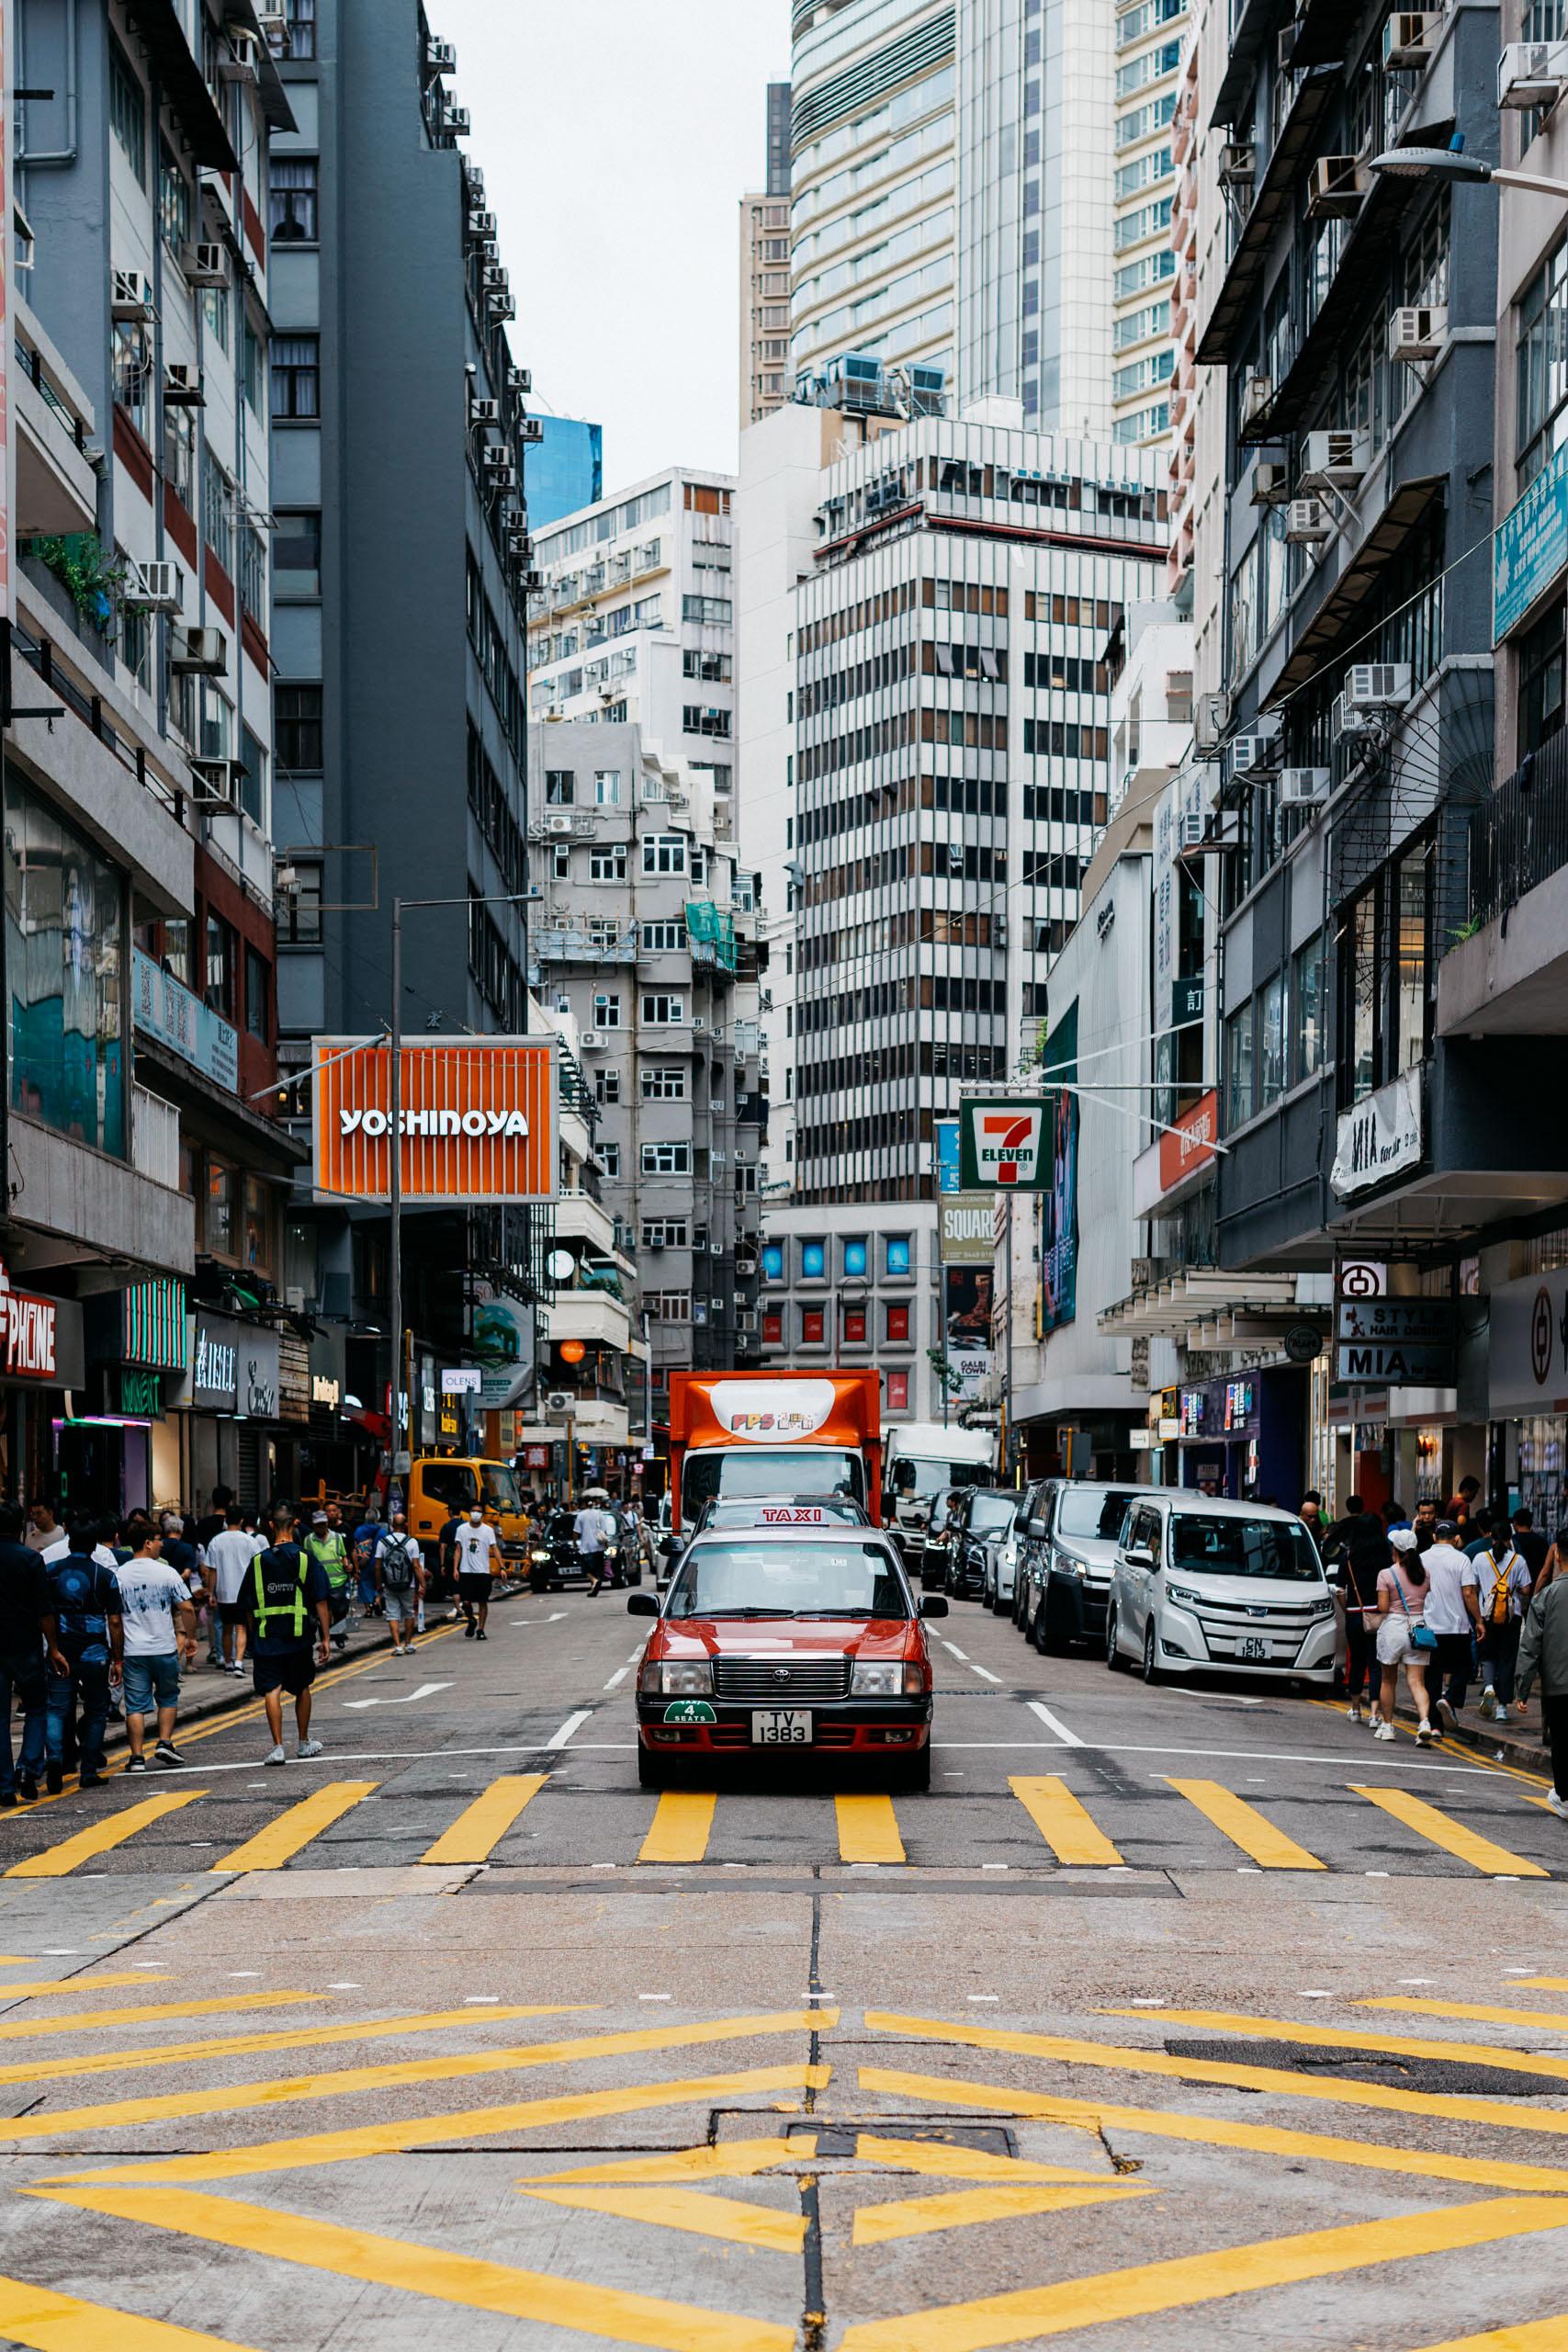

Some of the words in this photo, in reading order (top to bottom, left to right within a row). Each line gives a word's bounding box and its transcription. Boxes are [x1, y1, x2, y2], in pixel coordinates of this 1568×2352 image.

[339, 1109, 529, 1136] YOSHINOYA
[984, 1116, 1032, 1183] 7
[1374, 1308, 1446, 1324] STYLE
[7, 1296, 55, 1372] PHONE
[1371, 1325, 1398, 1336] HAIR
[1348, 1350, 1408, 1374] MIA
[960, 1367, 987, 1375] TOWN
[446, 1376, 478, 1386] OLENS
[731, 1414, 774, 1430] PPS
[762, 1509, 822, 1522] TAXI
[1246, 1637, 1263, 1648] CN
[683, 1704, 695, 1716] 4
[770, 1712, 796, 1727] TV
[760, 1727, 806, 1743] 1383
